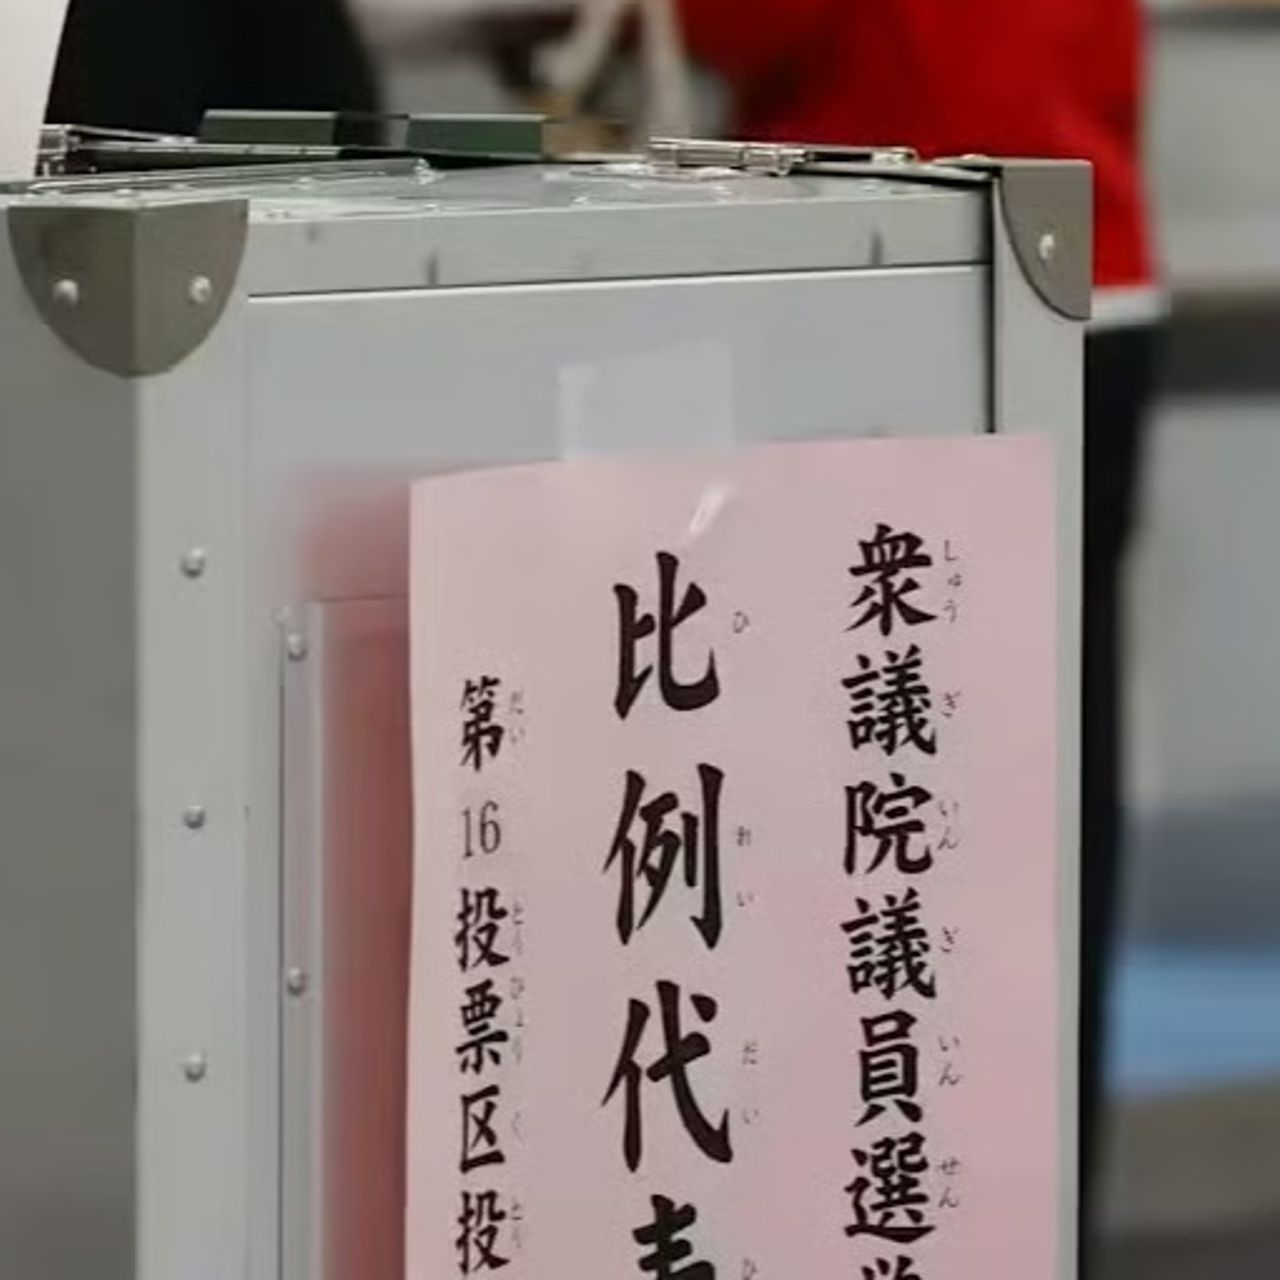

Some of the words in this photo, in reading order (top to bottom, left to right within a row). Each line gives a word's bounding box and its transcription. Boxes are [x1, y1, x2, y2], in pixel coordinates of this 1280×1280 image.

[942, 538, 963, 624] しゅう
[840, 523, 939, 1280] 衆議院議員選
